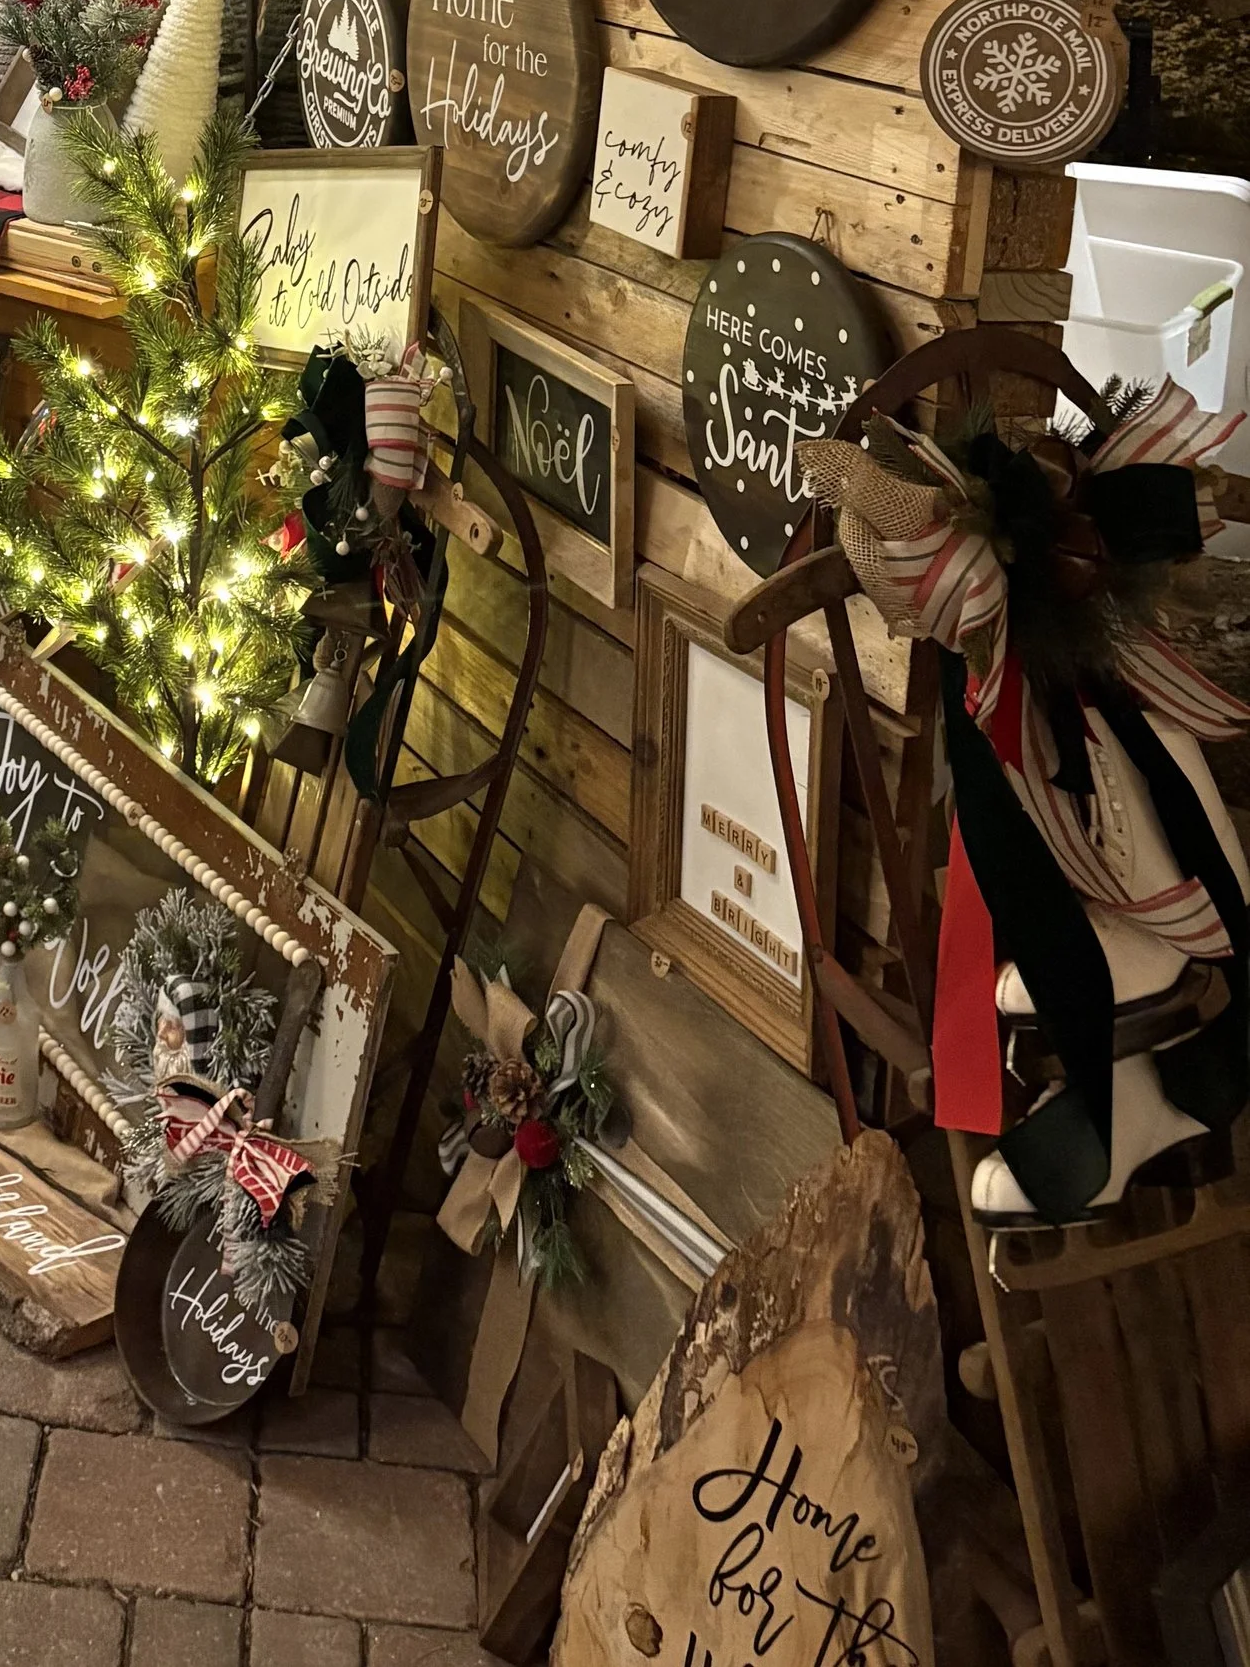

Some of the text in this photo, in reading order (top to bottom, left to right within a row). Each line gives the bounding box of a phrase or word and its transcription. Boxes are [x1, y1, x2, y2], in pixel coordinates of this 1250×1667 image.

[297, 17, 391, 119] Brewing Co
[483, 34, 548, 77] for the
[1063, 28, 1092, 73] MAIL
[307, 92, 332, 149] CHRIST
[323, 95, 356, 131] PREMIUM
[420, 39, 558, 182] Holidays
[942, 69, 1080, 143] EXPRESS DELIVERY
[594, 160, 673, 237] & cozy
[605, 131, 681, 192] comfy
[298, 260, 337, 329] Cold
[341, 243, 413, 324] Outside
[706, 304, 827, 381] HERE COMES
[505, 375, 600, 516] Noël
[702, 808, 772, 867] MERRY
[735, 873, 746, 888] &
[713, 897, 793, 970] BRIGHT
[169, 1266, 269, 1385] Holidays
[692, 1417, 882, 1573] Home
[709, 1523, 794, 1656] for
